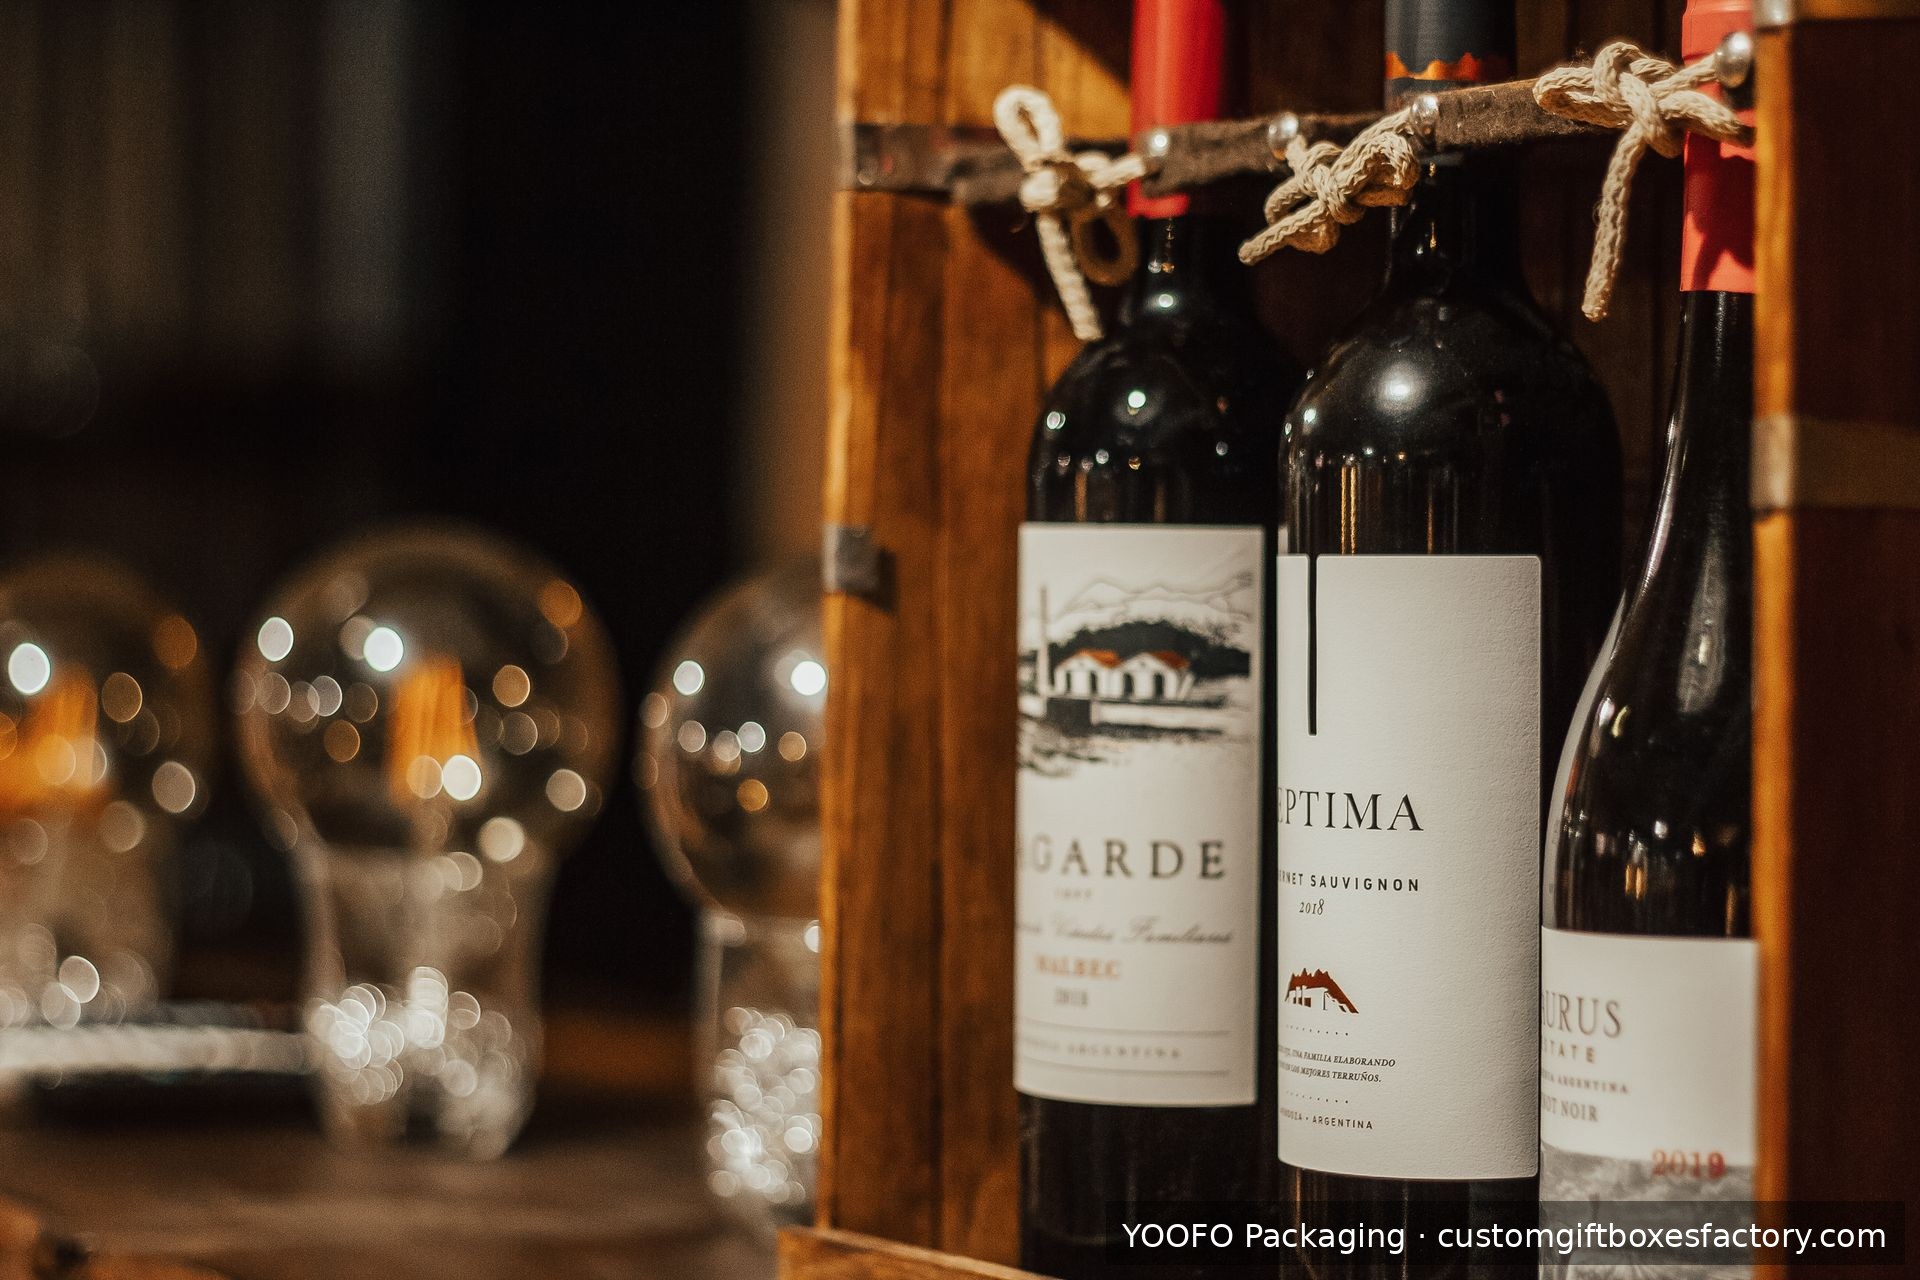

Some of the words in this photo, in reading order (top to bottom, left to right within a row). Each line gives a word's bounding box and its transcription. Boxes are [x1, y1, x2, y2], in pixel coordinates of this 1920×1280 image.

[1021, 833, 1227, 880] GARDE
[1310, 874, 1419, 892] SAUVIGNON
[1298, 898, 1325, 916] 2018
[1035, 954, 1122, 979] MALBEC
[1303, 1051, 1332, 1063] FAMILIA
[1333, 1055, 1396, 1068] ELABORANDO
[1300, 1067, 1331, 1078] MEJORES
[1331, 1071, 1382, 1083] TERRUÑOS.
[1557, 1074, 1630, 1095] ARGENTINA
[1560, 1101, 1599, 1122] NOIR
[1312, 1115, 1373, 1130] ARGENTINA
[1651, 1150, 1727, 1181] 2019
